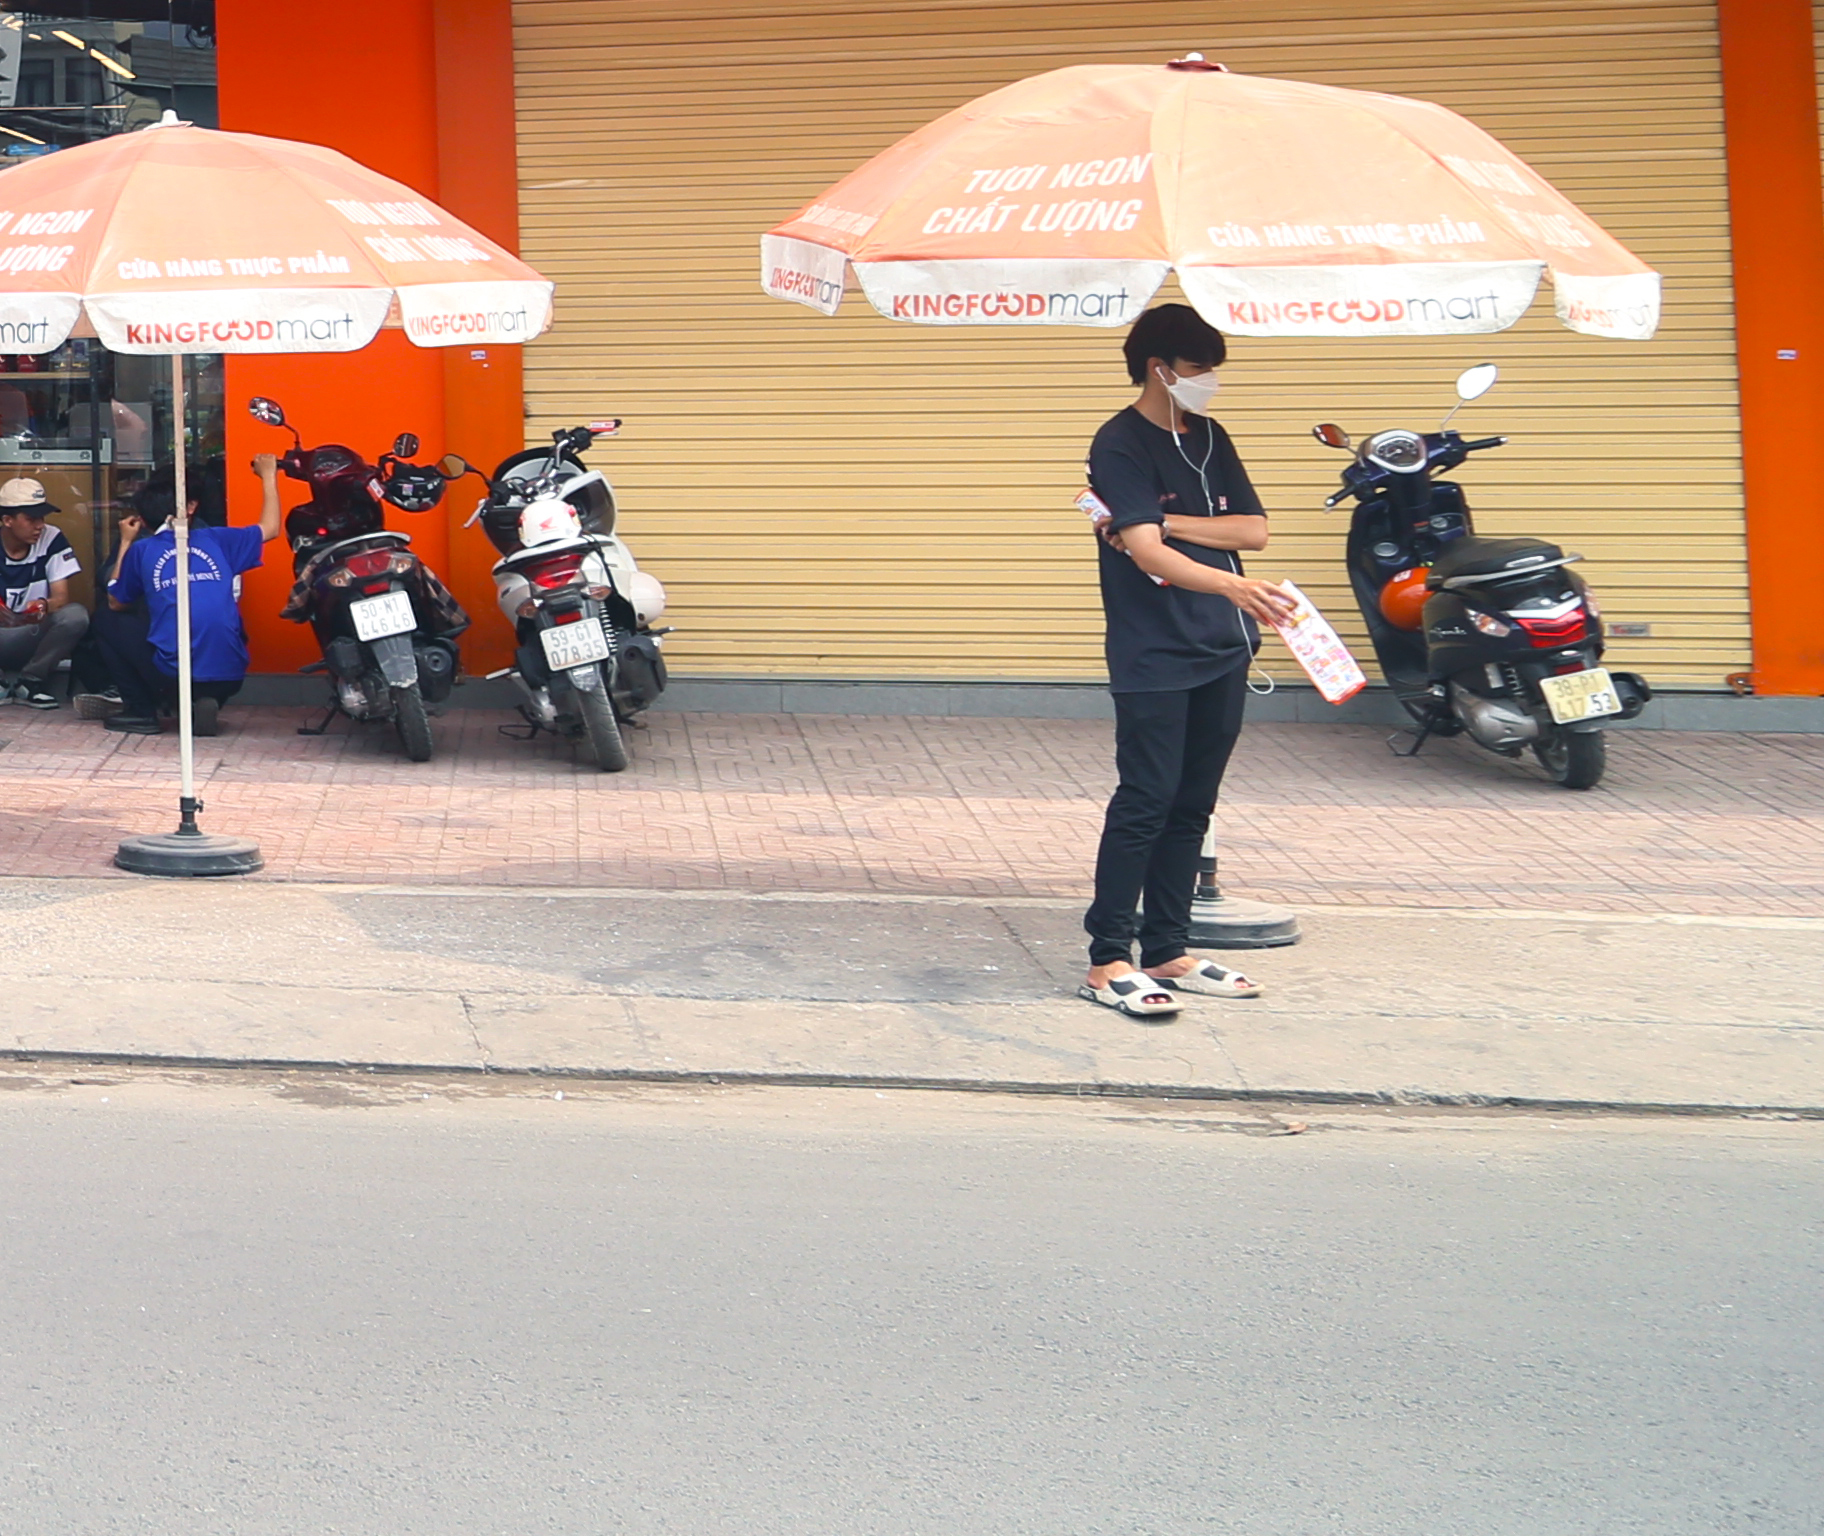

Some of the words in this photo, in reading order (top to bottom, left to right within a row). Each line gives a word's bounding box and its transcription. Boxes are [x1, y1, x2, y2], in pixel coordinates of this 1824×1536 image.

[964, 166, 1048, 194] TƯƠI
[1049, 153, 1153, 189] NGON
[9, 209, 94, 236] NGON
[922, 196, 1020, 234] CHẤT
[1020, 198, 1143, 238] LƯỢNG
[1207, 222, 1257, 247] CỬA
[1262, 223, 1331, 246] HÀNG
[1407, 214, 1486, 245] PHẨM
[118, 257, 161, 279] CỬA
[164, 257, 224, 277] HÀNG
[226, 255, 283, 278] THỰC
[291, 250, 351, 274] PHẨM
[893, 287, 1129, 318] KINGFOODmart
[1227, 290, 1500, 324] KINGFOODmart
[126, 313, 353, 347] KINGFOODmart
[408, 305, 527, 337] KINGFOODmart
[360, 597, 402, 620] 50-N1
[550, 626, 593, 649] 59-G1
